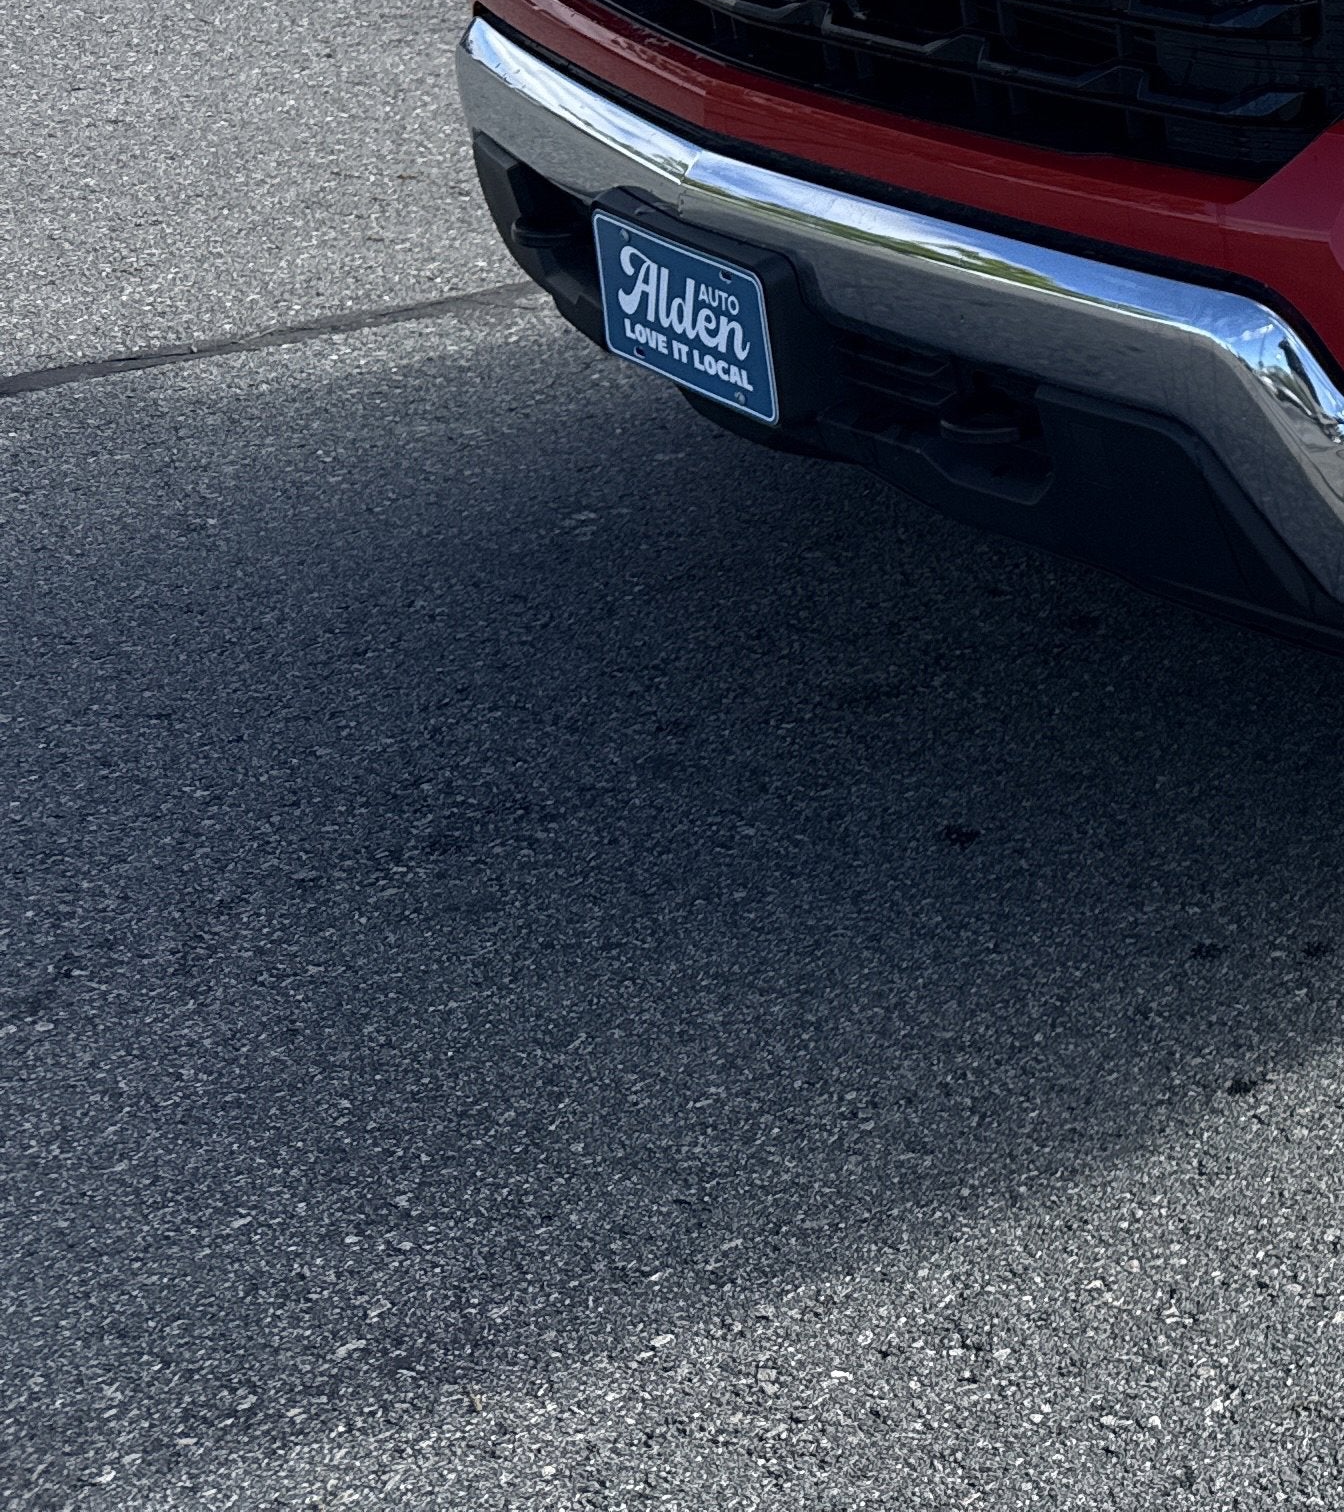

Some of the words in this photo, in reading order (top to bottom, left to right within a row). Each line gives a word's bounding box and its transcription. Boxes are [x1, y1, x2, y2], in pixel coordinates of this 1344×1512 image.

[618, 245, 750, 361] Alden
[698, 284, 739, 316] AUTO
[623, 318, 668, 355] LOVE
[672, 340, 689, 364] IT
[693, 353, 754, 392] LOCAL
